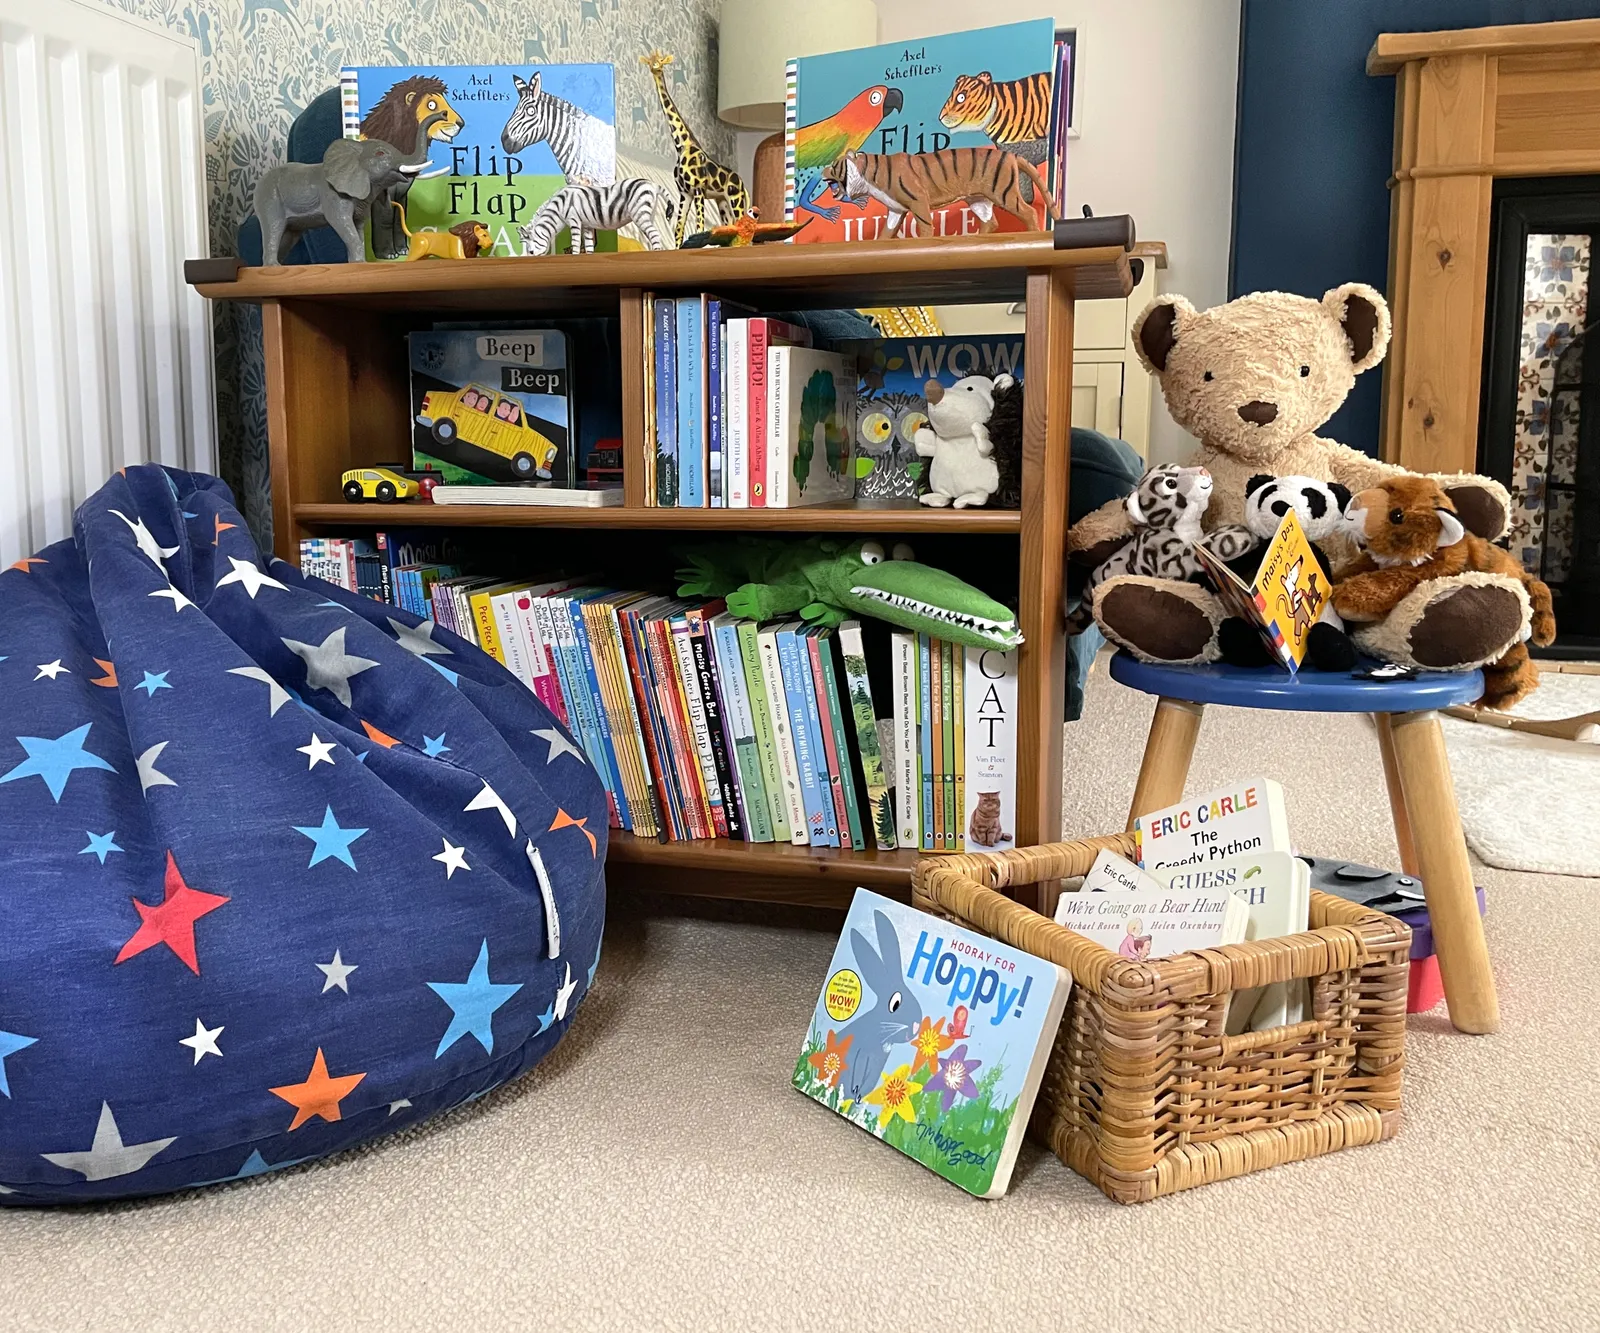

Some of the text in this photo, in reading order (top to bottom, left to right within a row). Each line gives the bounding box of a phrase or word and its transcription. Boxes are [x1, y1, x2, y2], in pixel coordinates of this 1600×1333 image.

[900, 47, 926, 62] Axel
[467, 73, 493, 86] Axel
[884, 63, 943, 81] Scheffler's
[452, 88, 510, 102] Scheffler's
[879, 122, 951, 156] Flip
[449, 145, 523, 187] Flip
[448, 181, 527, 223] Flap
[485, 338, 535, 362] Beep
[752, 333, 763, 387] PEEPO!
[907, 342, 1022, 378] WOW
[508, 369, 560, 394] Beep
[734, 393, 740, 403] OF
[1262, 544, 1284, 592] Maisy's
[1281, 521, 1294, 543] Day
[479, 605, 498, 660] PECK PECK PE
[678, 636, 687, 654] Axel
[578, 628, 591, 671] MITTON PARKER
[743, 631, 763, 688] Monkey Puzzle
[541, 680, 549, 698] What
[681, 656, 698, 695] Scheffler's
[694, 643, 716, 718] Maisy Goes to Bed
[799, 648, 807, 665] What
[808, 702, 816, 721] Winter
[688, 697, 705, 722] Flip
[977, 650, 1006, 748] CAT
[594, 692, 608, 739] DAZZLING DIGGERS
[694, 723, 710, 750] Flap
[711, 730, 721, 747] Lucy
[794, 708, 814, 789] THE RHYMING RABBIT
[976, 755, 1005, 763] Van Fleet
[703, 753, 720, 797] PETS
[1151, 787, 1258, 840] ERIC CARLE
[1190, 829, 1218, 847] The
[1209, 835, 1261, 861] Python
[1103, 864, 1137, 892] Eric Carle
[1169, 867, 1237, 890] GUESS
[1066, 898, 1227, 919] We're Going on a Bear Hunt
[1064, 921, 1121, 931] Michael Rosen
[1150, 920, 1223, 932] Helen Oxenbury
[950, 939, 1017, 974] HOORAY FOR
[906, 929, 1034, 1027] Hoppy!
[829, 993, 856, 1009] WOW!
